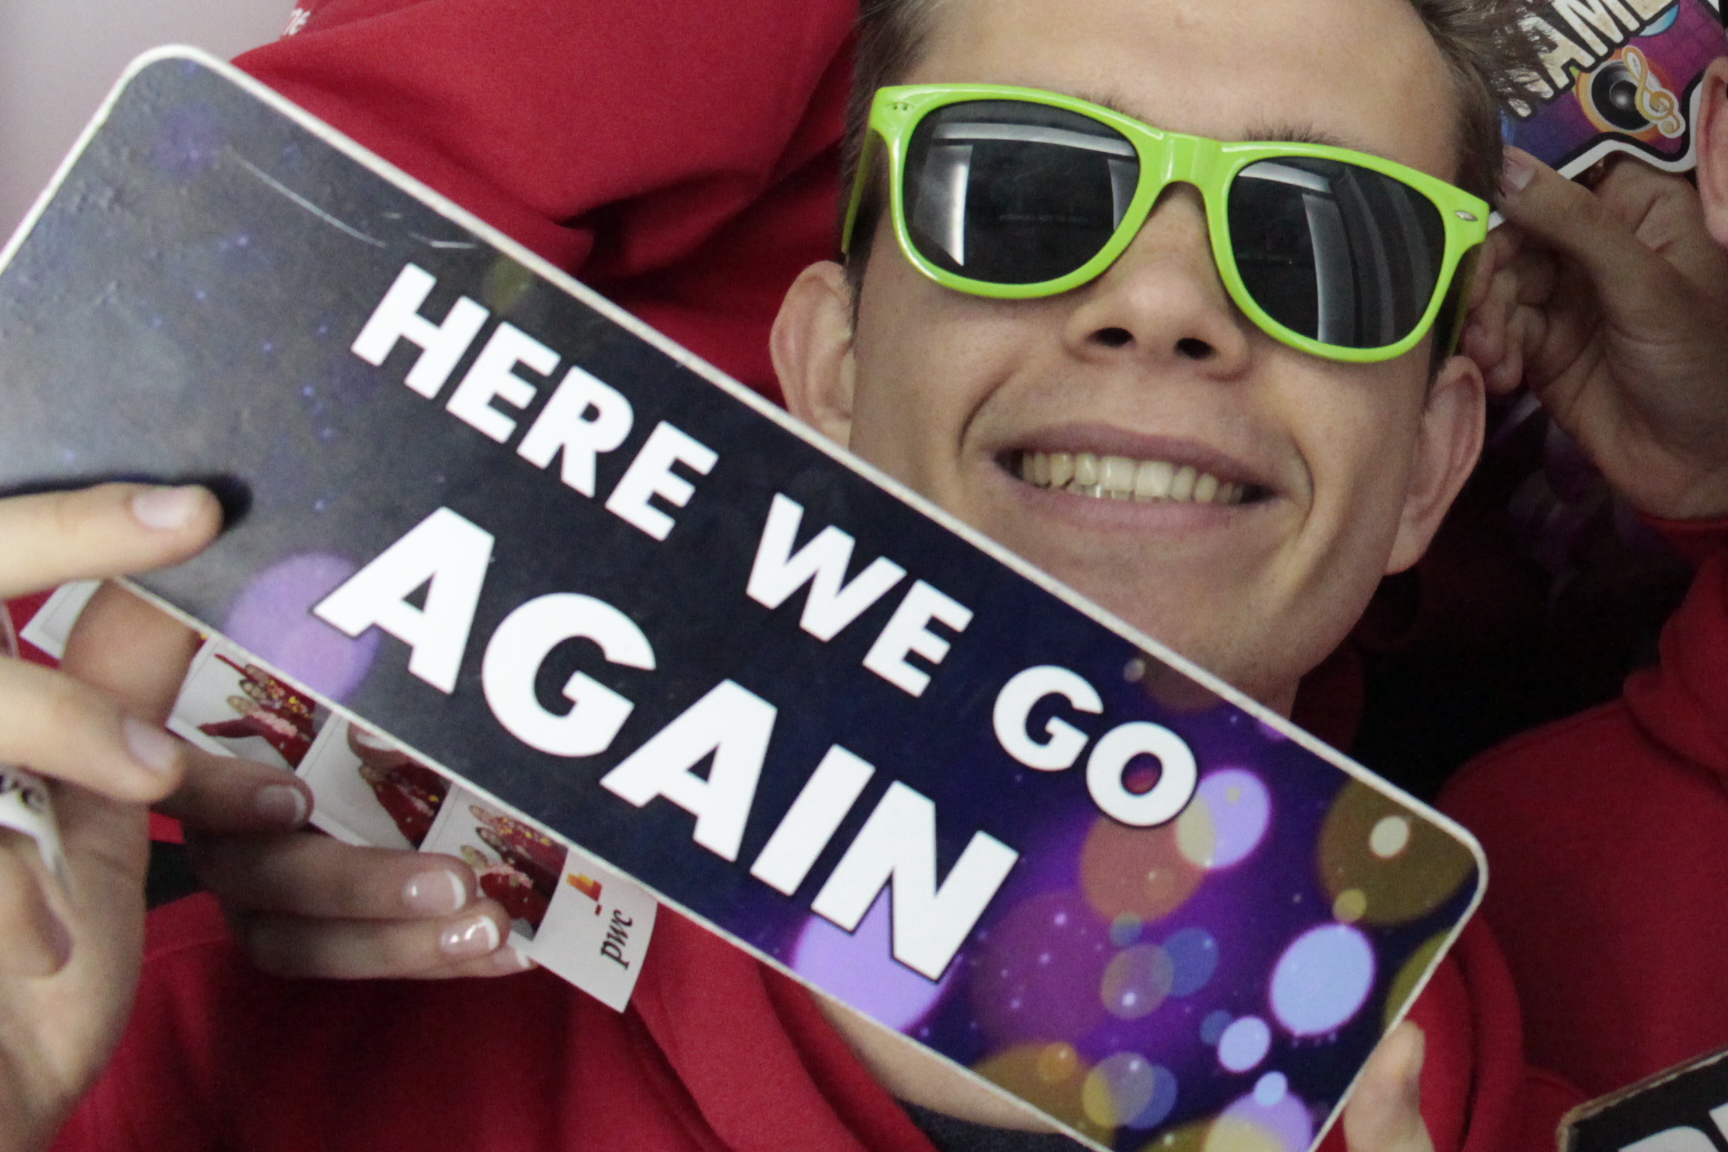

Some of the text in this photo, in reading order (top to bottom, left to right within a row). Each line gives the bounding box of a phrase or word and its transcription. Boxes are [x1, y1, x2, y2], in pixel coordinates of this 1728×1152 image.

[313, 507, 1019, 981] AGAIN
[352, 263, 1198, 827] HERE WE GO
[600, 909, 634, 970] pwc
